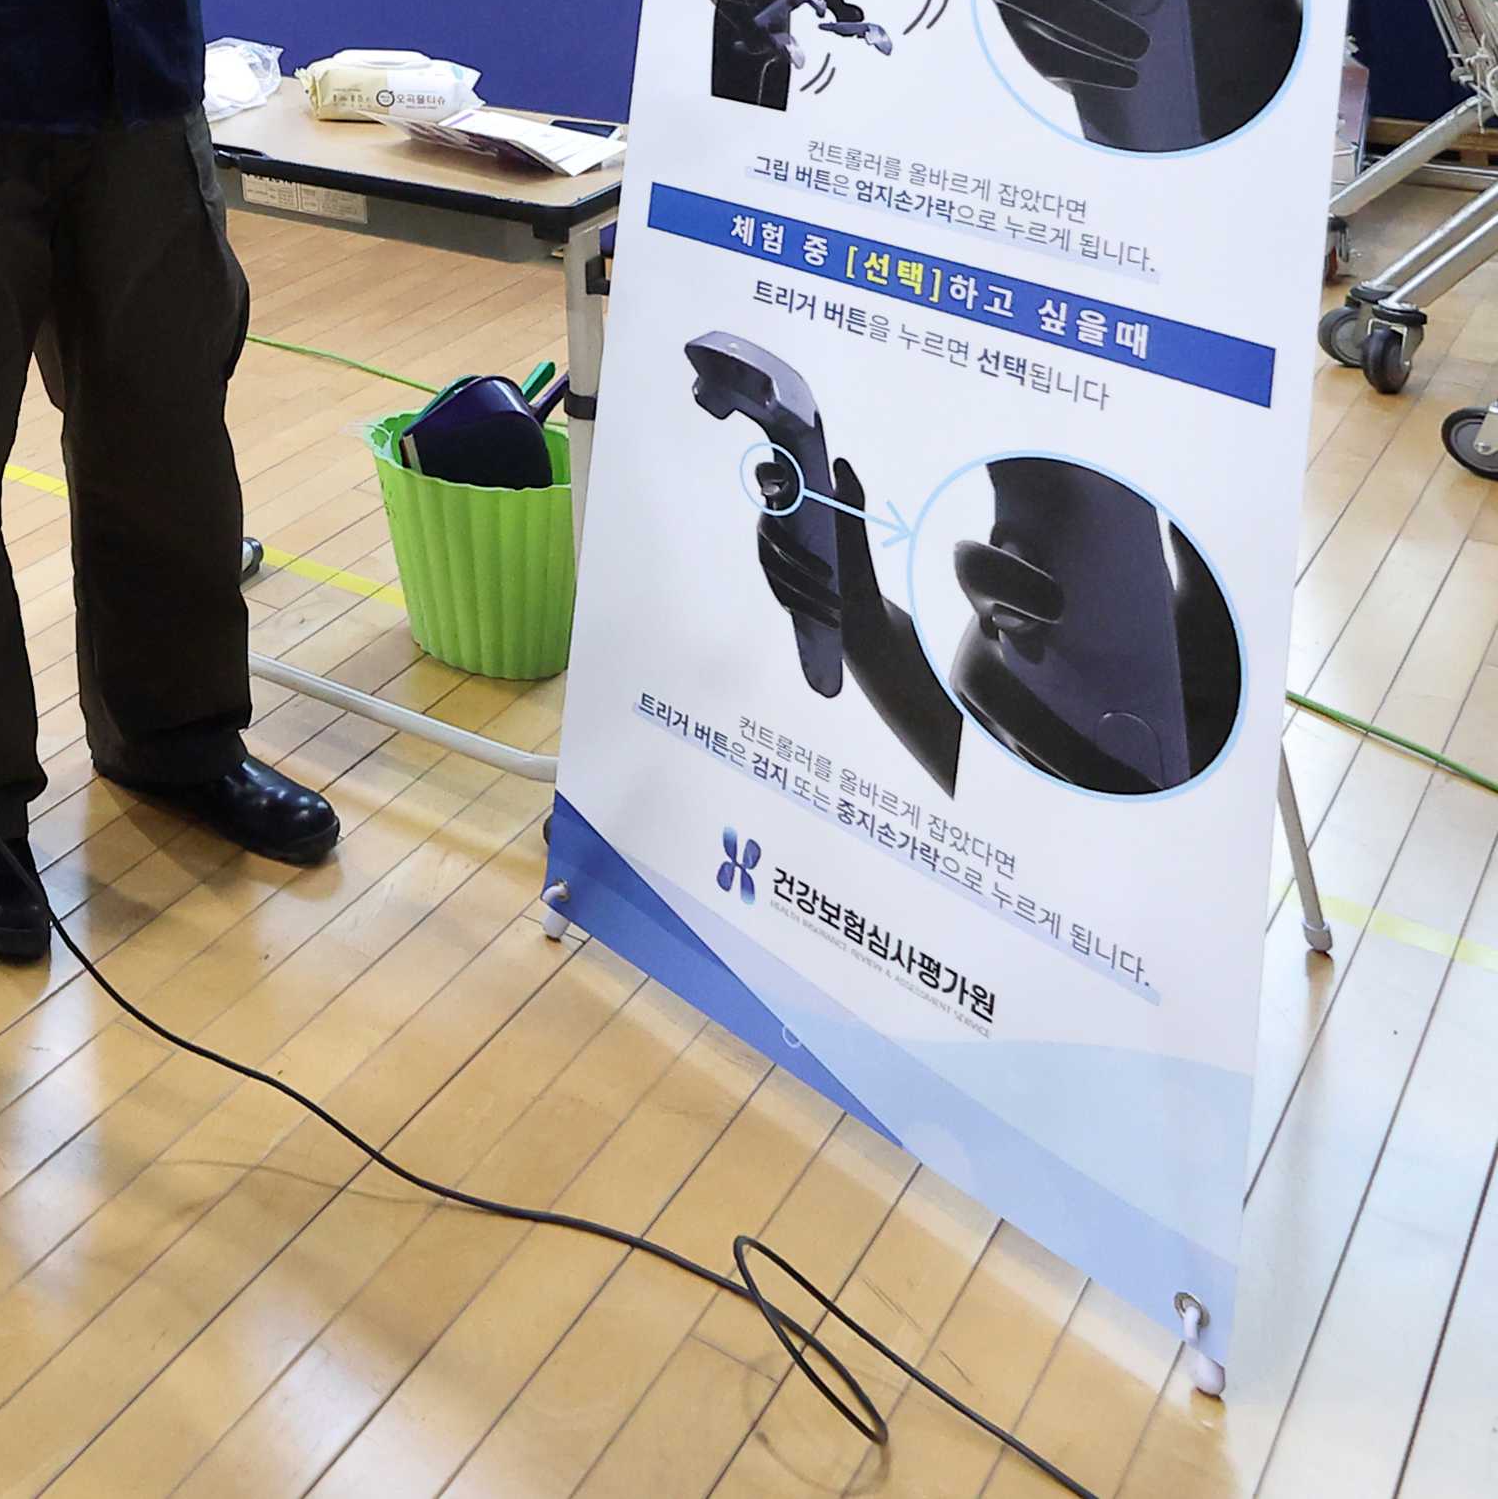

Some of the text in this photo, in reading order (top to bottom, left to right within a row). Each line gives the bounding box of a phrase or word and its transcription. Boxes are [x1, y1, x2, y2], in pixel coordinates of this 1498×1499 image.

[753, 156, 1155, 274] 그립 버튼은 엄지손가락으로 누르게 됩니다.
[806, 140, 1087, 224] 컨트롤러를 올바르게 잡았다면
[731, 214, 1149, 360] 체험 중 [선택]하고 싶을때
[752, 281, 1110, 410] 트리거 버튼을 누르면 선택됩니다
[639, 693, 1151, 986] 트리거 버튼은 검지 또는 중지손가락으로 누르게 됩니다.
[739, 714, 1016, 879] 컨트롤러를 올바르게 잡았다면
[773, 867, 995, 1023] 건강보험심사평가원
